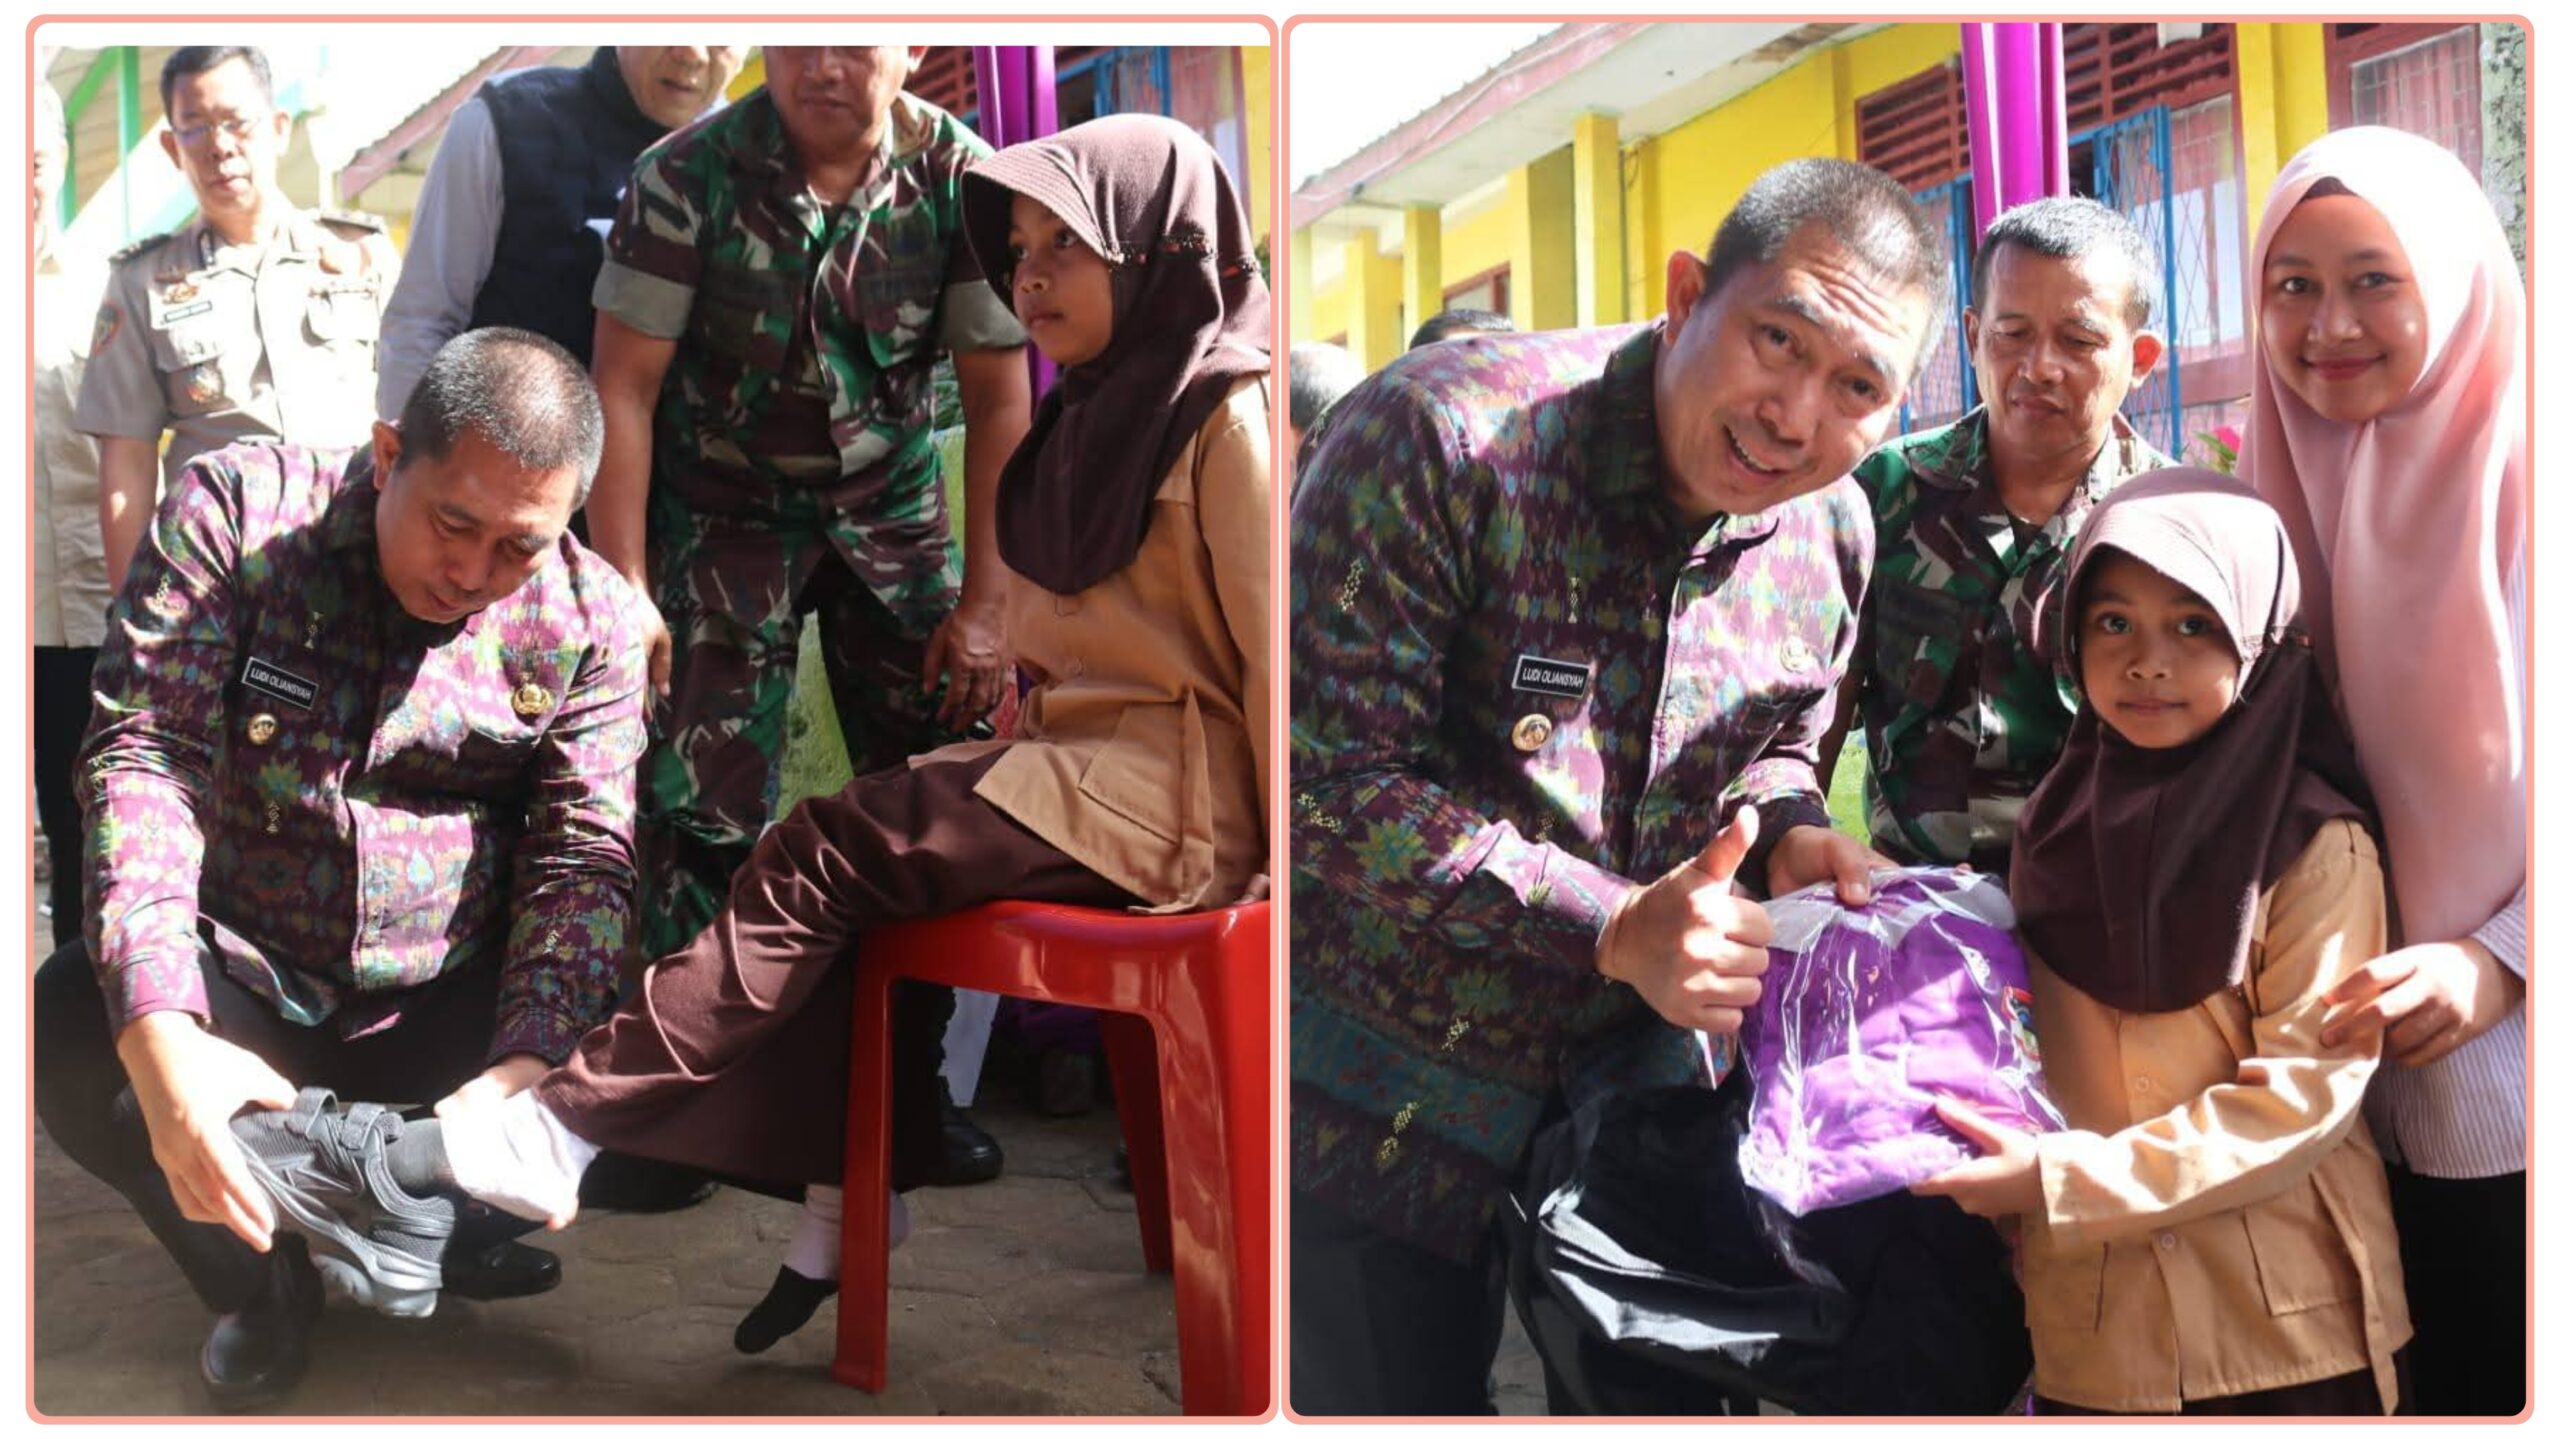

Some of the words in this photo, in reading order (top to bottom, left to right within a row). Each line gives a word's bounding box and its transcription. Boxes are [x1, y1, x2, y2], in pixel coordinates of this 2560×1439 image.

[250, 668, 269, 683] LUDI
[269, 675, 312, 700] OLIANSYAH
[1522, 668, 1541, 682] LUDI
[1541, 670, 1584, 688] OLIANSYAH
